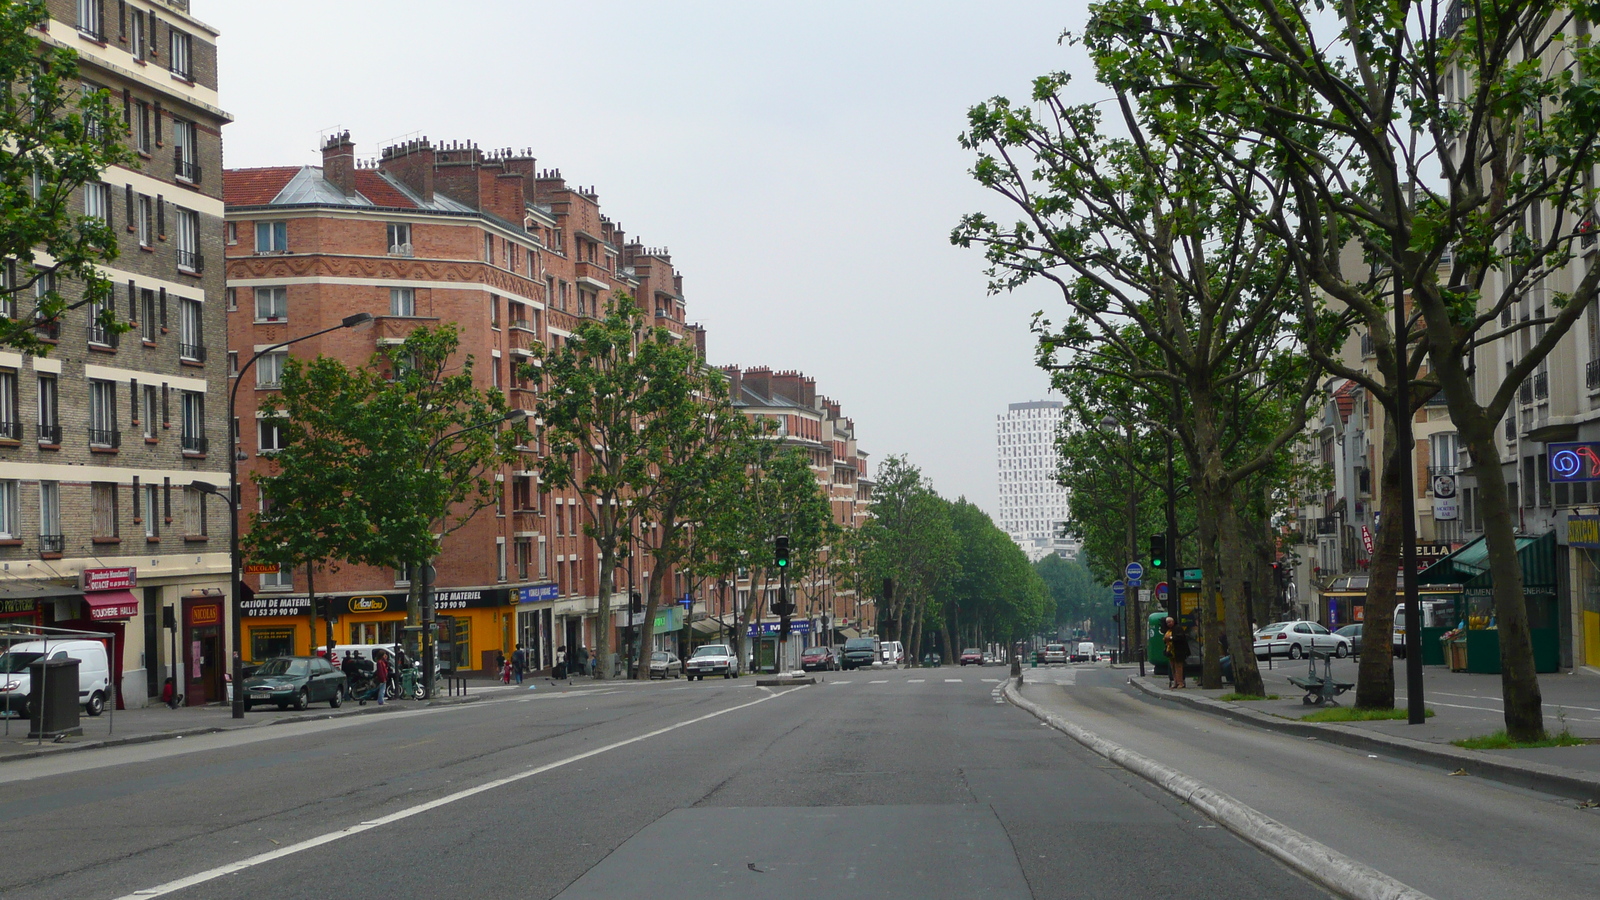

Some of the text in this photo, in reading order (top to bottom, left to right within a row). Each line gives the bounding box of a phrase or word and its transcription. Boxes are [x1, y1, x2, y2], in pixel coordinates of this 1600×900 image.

[1361, 525, 1373, 554] TABAC
[440, 591, 481, 600] DE MATERIEL
[1465, 586, 1554, 596] ALIMENT ENERALE
[240, 598, 311, 608] CATION DE MATERIE
[193, 608, 216, 620] NICOLAS
[259, 608, 267, 616] 53
[269, 608, 277, 616] 39
